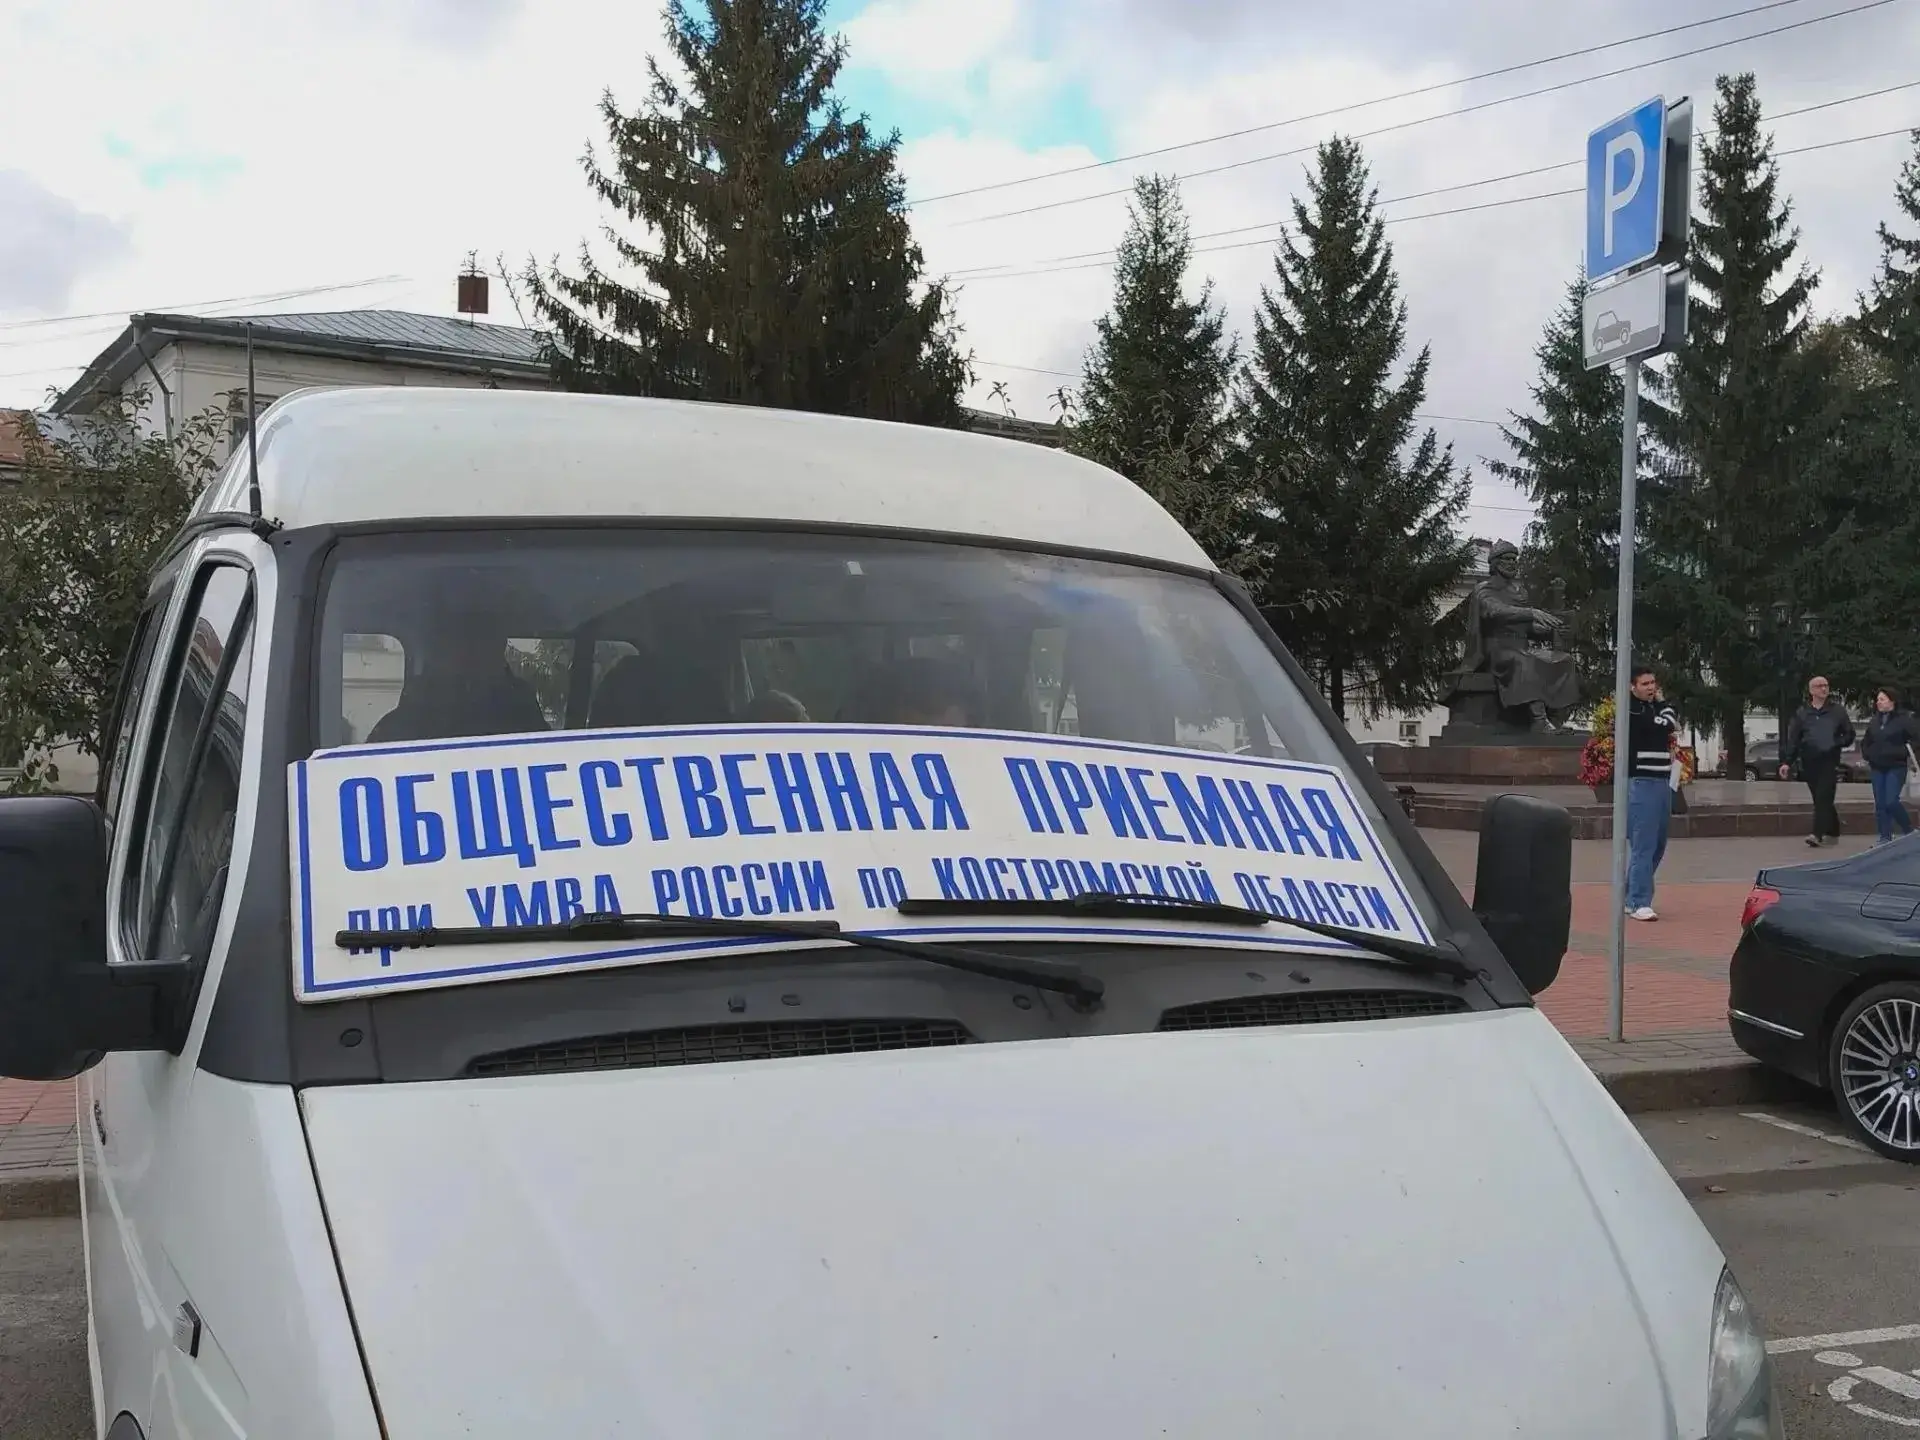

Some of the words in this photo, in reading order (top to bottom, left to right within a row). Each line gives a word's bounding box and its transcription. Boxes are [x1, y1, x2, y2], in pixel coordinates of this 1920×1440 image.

[1603, 130, 1645, 258] P
[338, 752, 970, 872] ОБЩЕСТВЕННАЯ
[1003, 756, 1362, 862] ПРИЕМНАЯ
[466, 874, 622, 929] УМВА
[651, 860, 835, 921] РОССИИ
[931, 857, 1221, 907] КОСТРОМСКОЙ
[1233, 872, 1401, 931] ОБЛАСТИ
